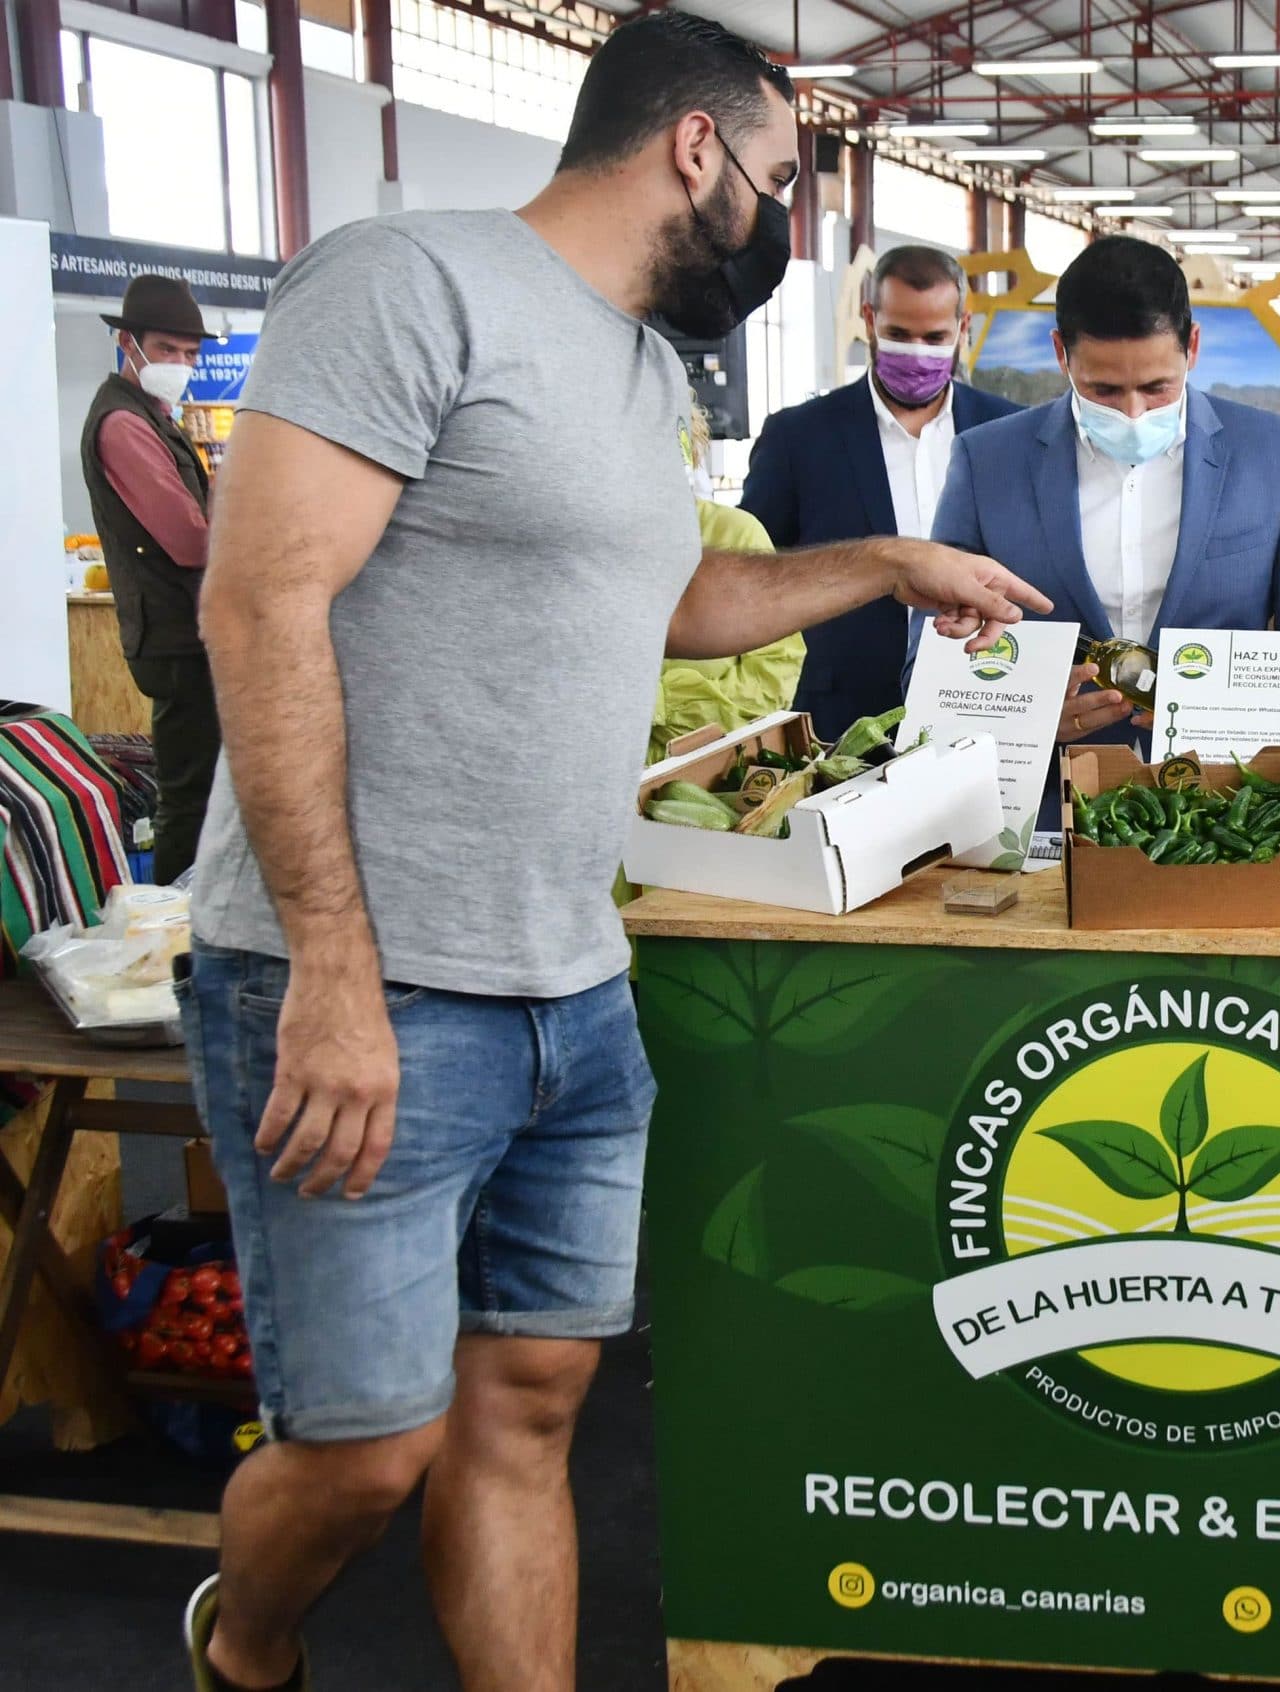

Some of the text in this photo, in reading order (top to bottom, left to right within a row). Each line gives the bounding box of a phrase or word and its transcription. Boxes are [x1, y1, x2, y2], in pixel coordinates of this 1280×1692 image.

[61, 255, 127, 278] ARTESANOS
[182, 267, 229, 289] MEDEROS
[230, 272, 260, 291] DESDE
[1234, 651, 1259, 660] HAZ
[1262, 652, 1278, 660] TU
[938, 689, 1033, 703] PROYECTO FINCAS
[984, 704, 1027, 713] CANARIAS
[949, 1079, 1023, 1259] FINCAS
[1016, 983, 1280, 1080] ORGÁNICA
[952, 1305, 1006, 1346] DE
[1008, 1291, 1058, 1324] LA
[1063, 1275, 1213, 1310] HUERTA
[1222, 1281, 1248, 1309] A
[1025, 1366, 1157, 1439] PRODUCTOS
[1166, 1425, 1196, 1443] DE
[805, 1474, 1181, 1536] RECOLECTAR
[1198, 1495, 1238, 1539] &
[881, 1581, 1146, 1615] organica_canarias
